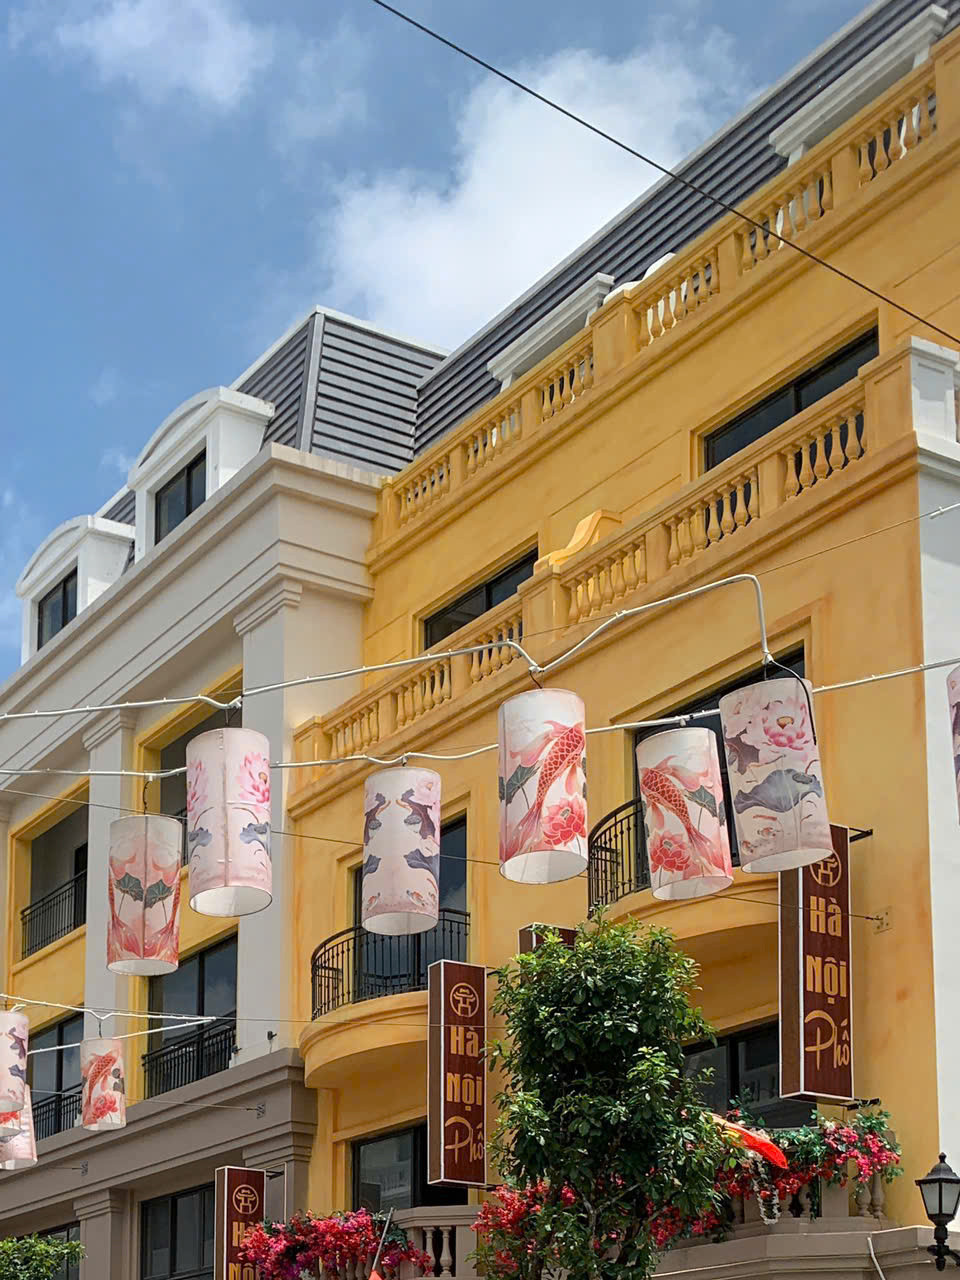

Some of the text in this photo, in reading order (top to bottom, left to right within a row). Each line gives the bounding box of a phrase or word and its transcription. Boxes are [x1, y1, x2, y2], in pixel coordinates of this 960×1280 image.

[809, 896, 842, 937] Hà
[806, 955, 847, 1004] Nội
[450, 1025, 479, 1057] Hà
[804, 1010, 850, 1071] Phố
[447, 1072, 482, 1111] Nội
[444, 1115, 483, 1164] Phố
